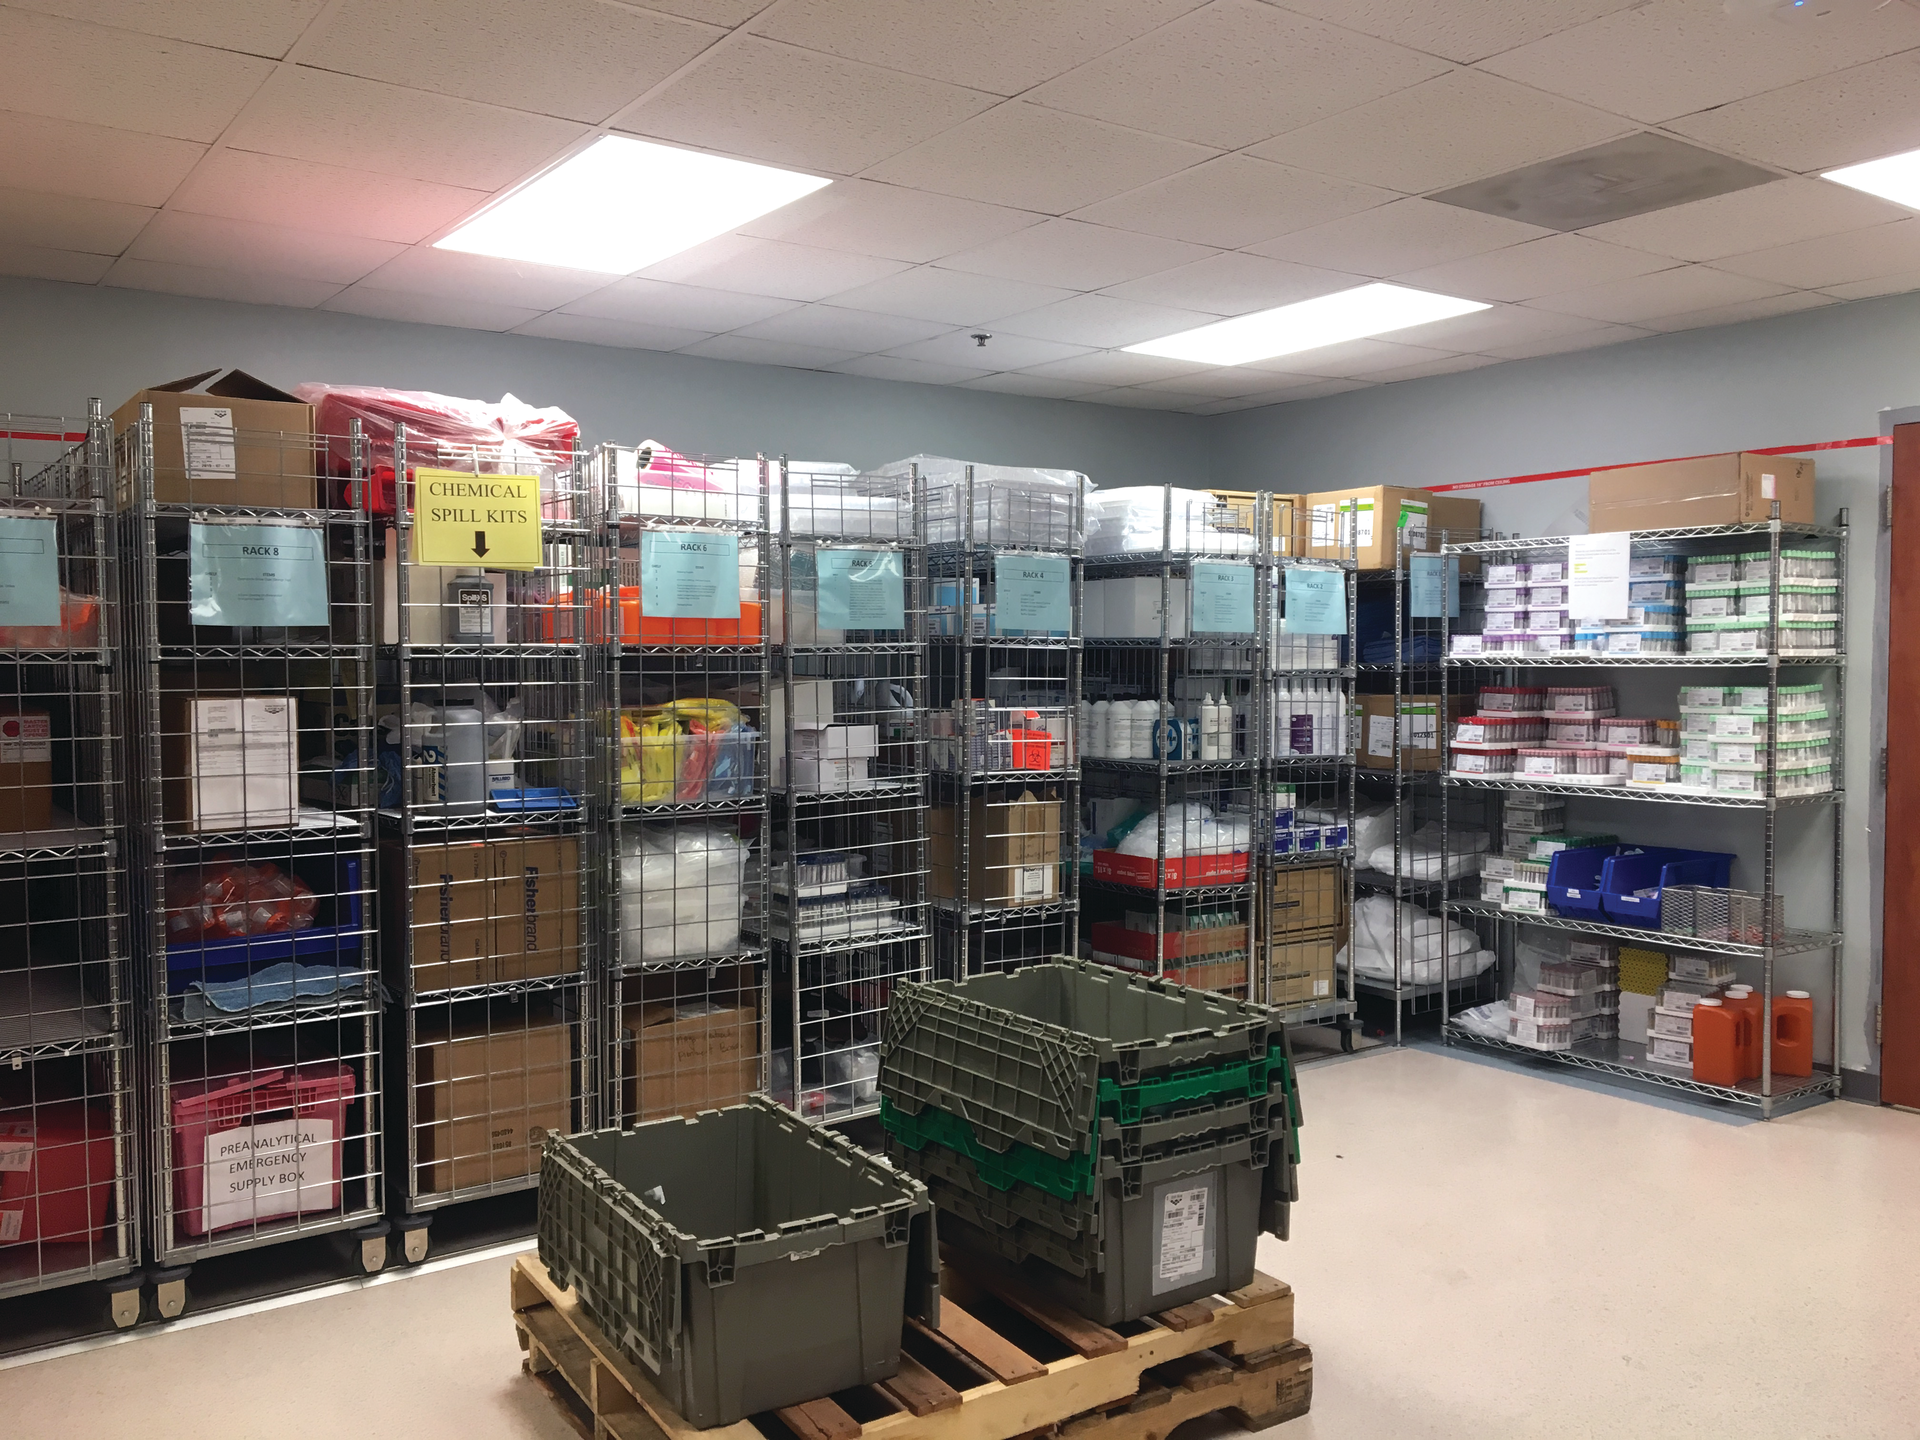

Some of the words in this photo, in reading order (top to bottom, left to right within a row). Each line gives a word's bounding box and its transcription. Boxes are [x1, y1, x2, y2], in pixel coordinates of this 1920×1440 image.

[430, 482, 527, 498] CHEMICAL
[432, 508, 481, 522] SPILL
[487, 510, 527, 523] KITS
[242, 547, 271, 555] RACK
[273, 548, 279, 556] 8
[423, 750, 436, 763] 2
[526, 866, 539, 952] Fisherbrand
[220, 1134, 317, 1156] PREANALYTICAL
[230, 1152, 306, 1174] EMERGENCY
[230, 1175, 275, 1193] SUPPLY
[280, 1172, 305, 1184] BOX
